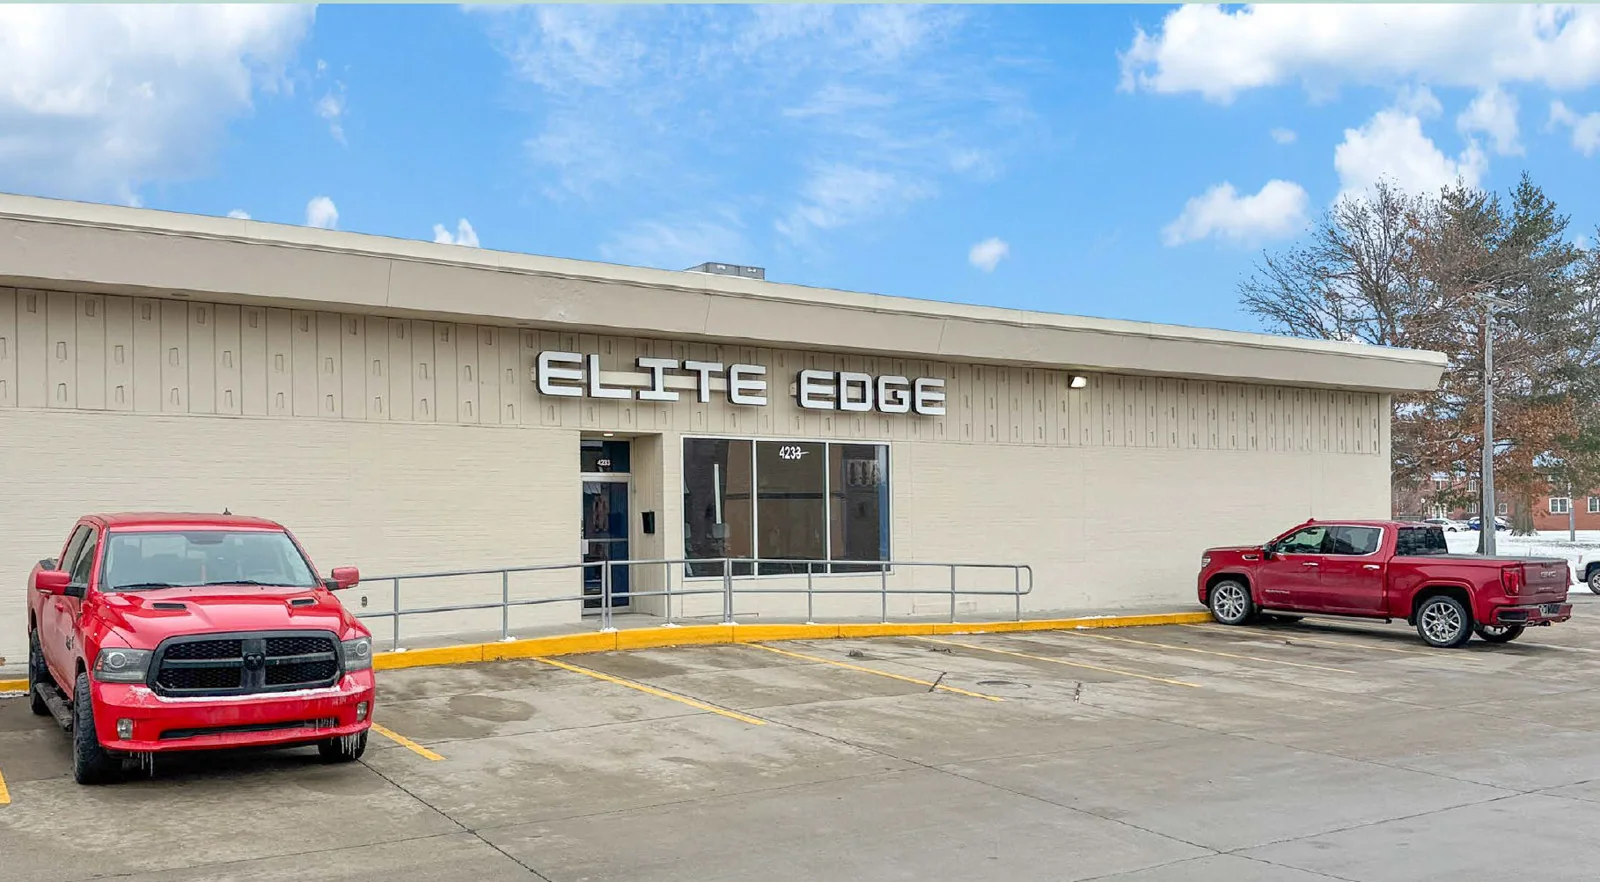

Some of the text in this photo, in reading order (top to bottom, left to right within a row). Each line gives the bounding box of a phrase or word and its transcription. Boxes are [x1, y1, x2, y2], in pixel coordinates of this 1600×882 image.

[536, 350, 946, 416] ELITE EDGE
[779, 446, 802, 460] 4233
[597, 459, 611, 467] 4233
